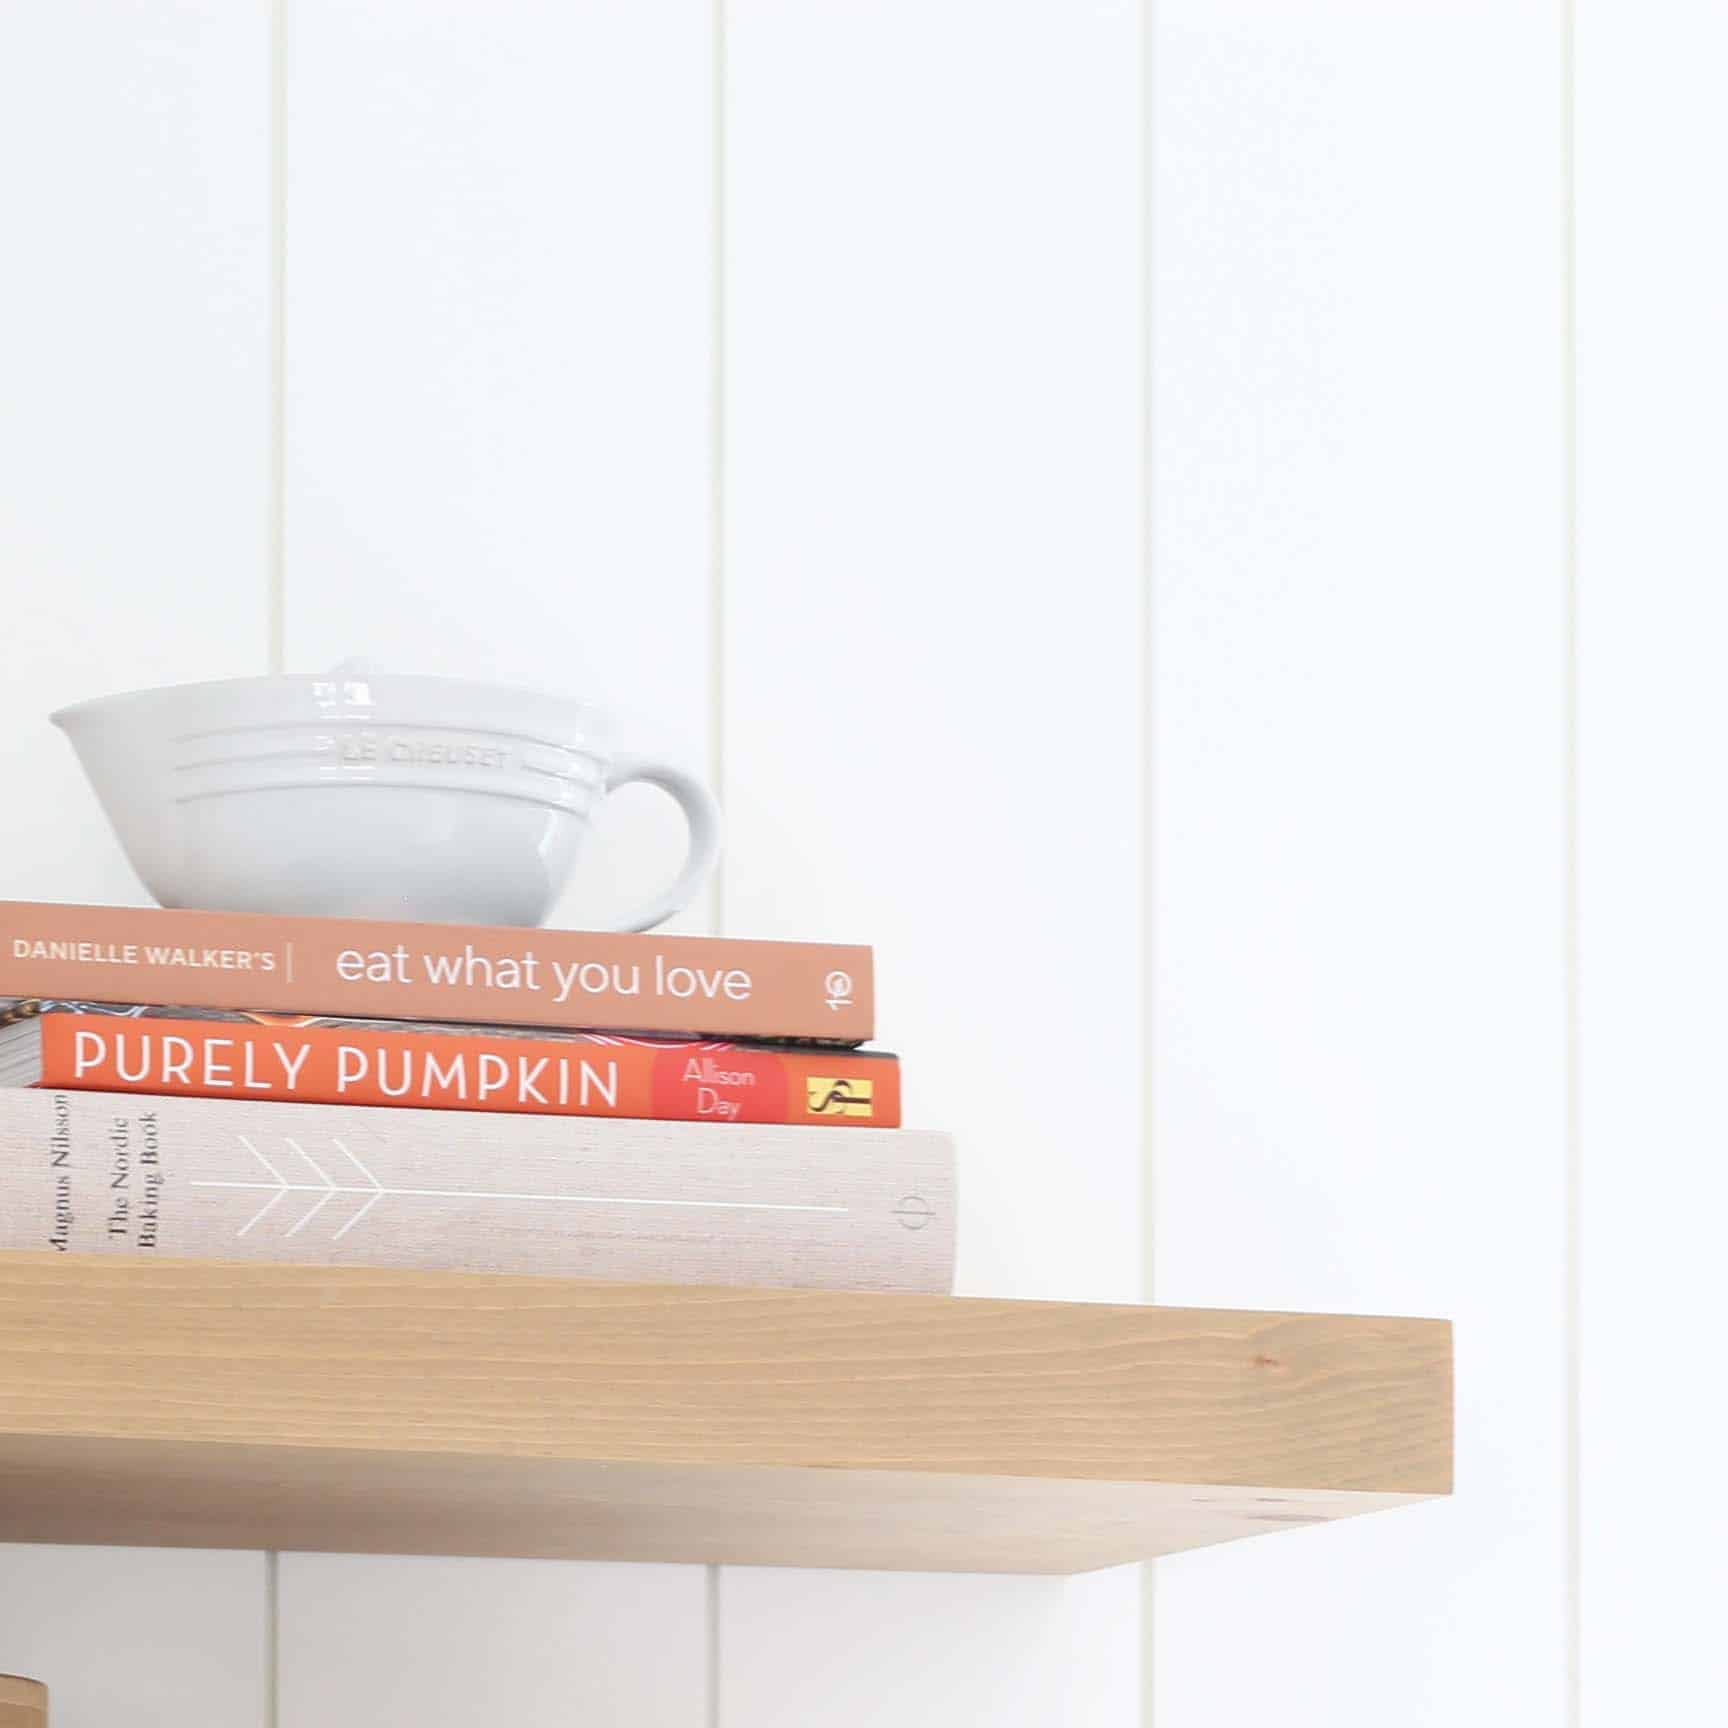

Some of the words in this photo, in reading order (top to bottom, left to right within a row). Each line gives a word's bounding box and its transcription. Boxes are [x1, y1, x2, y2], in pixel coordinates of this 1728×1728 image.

[13, 939, 139, 964] DANIELLE
[144, 946, 277, 971] WALKER'S
[336, 945, 410, 984] eat
[423, 945, 541, 991] what
[552, 961, 641, 1003] you
[655, 955, 753, 1001] love
[74, 1031, 312, 1090] PURELY
[336, 1046, 619, 1108] PUMPKIN
[683, 1058, 757, 1086] Allison
[50, 1094, 71, 1168] Nilsson
[697, 1087, 742, 1120] Day
[107, 1117, 129, 1190] Nordic
[137, 1112, 159, 1165] Book
[106, 1197, 129, 1240] The
[136, 1174, 166, 1247] Baking
